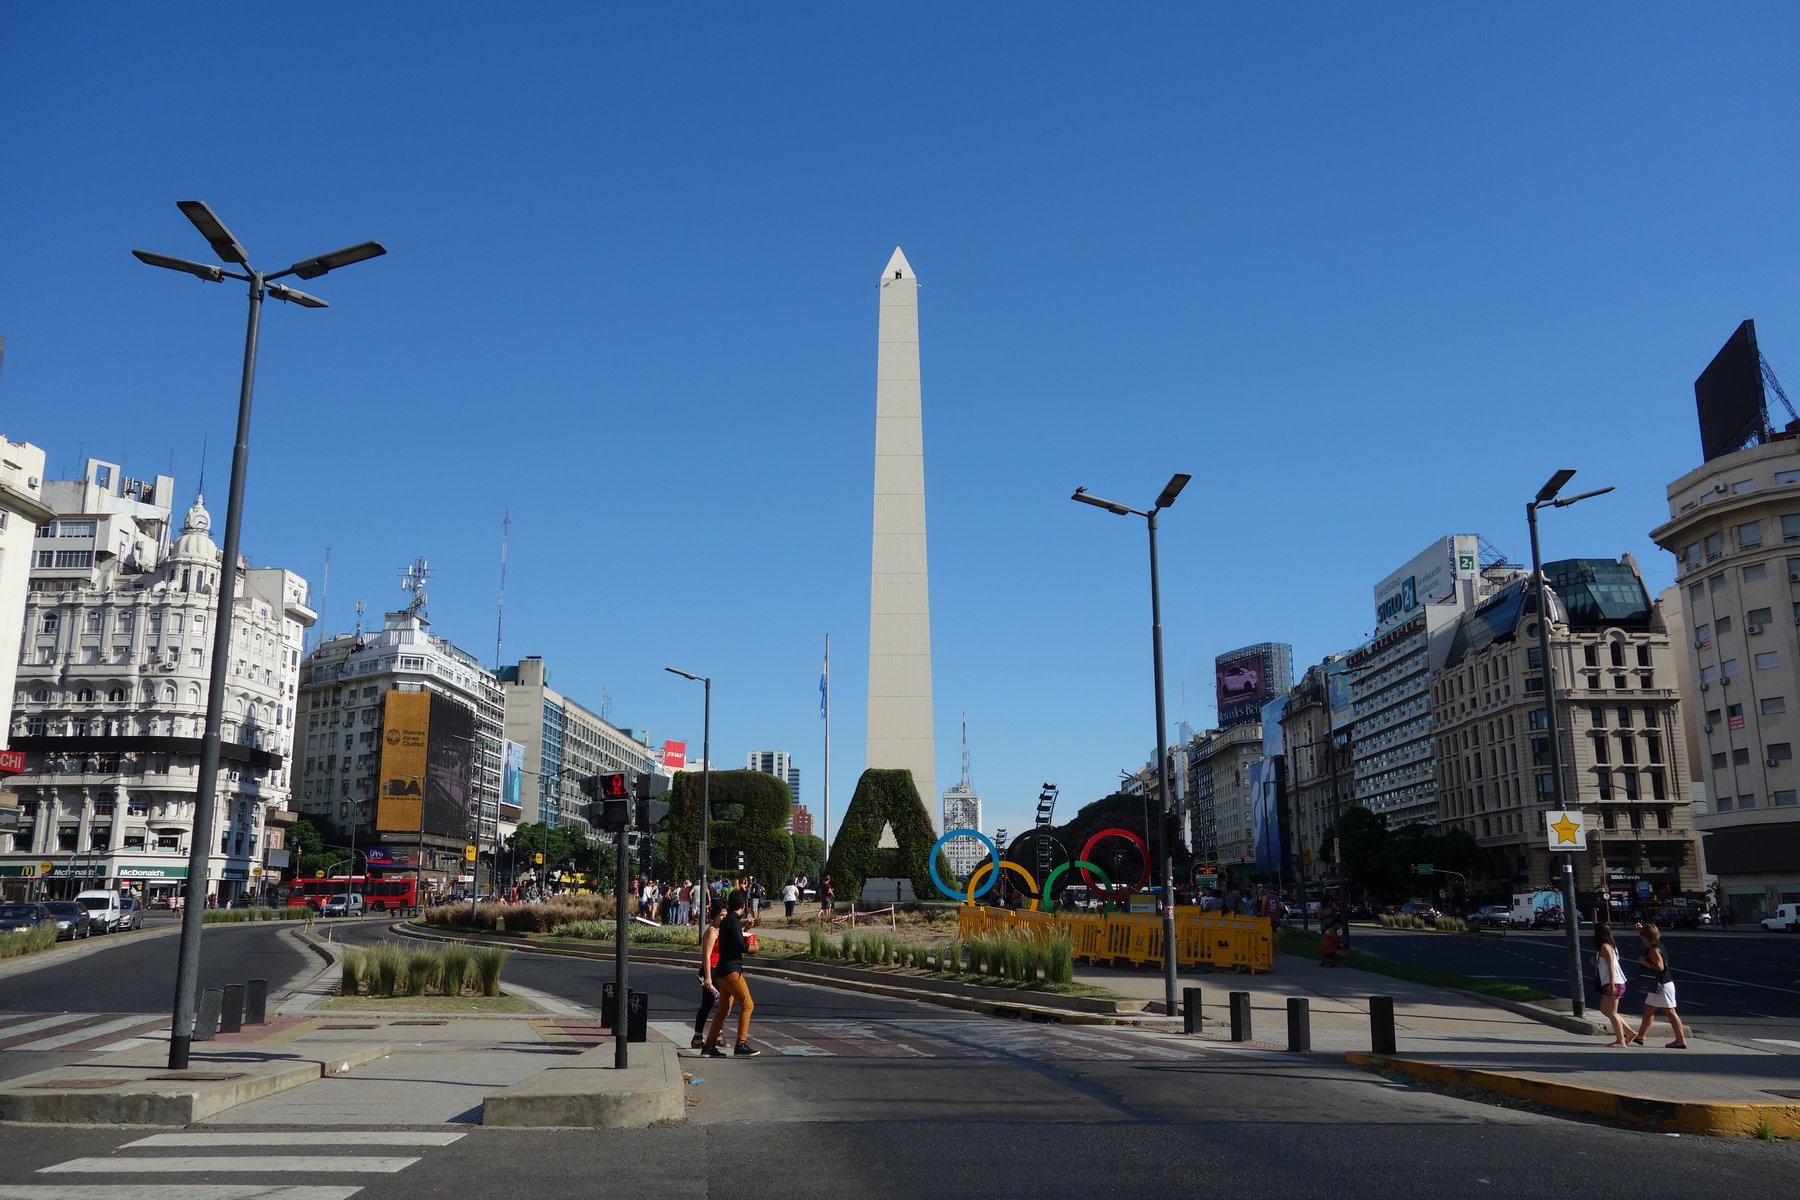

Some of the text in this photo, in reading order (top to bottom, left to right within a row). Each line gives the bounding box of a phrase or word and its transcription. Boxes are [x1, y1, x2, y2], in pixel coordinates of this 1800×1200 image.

[1461, 558, 1473, 570] 21
[1377, 585, 1414, 624] SIGLO 21
[1, 753, 22, 769] CHI
[119, 869, 165, 877] McDonald's
